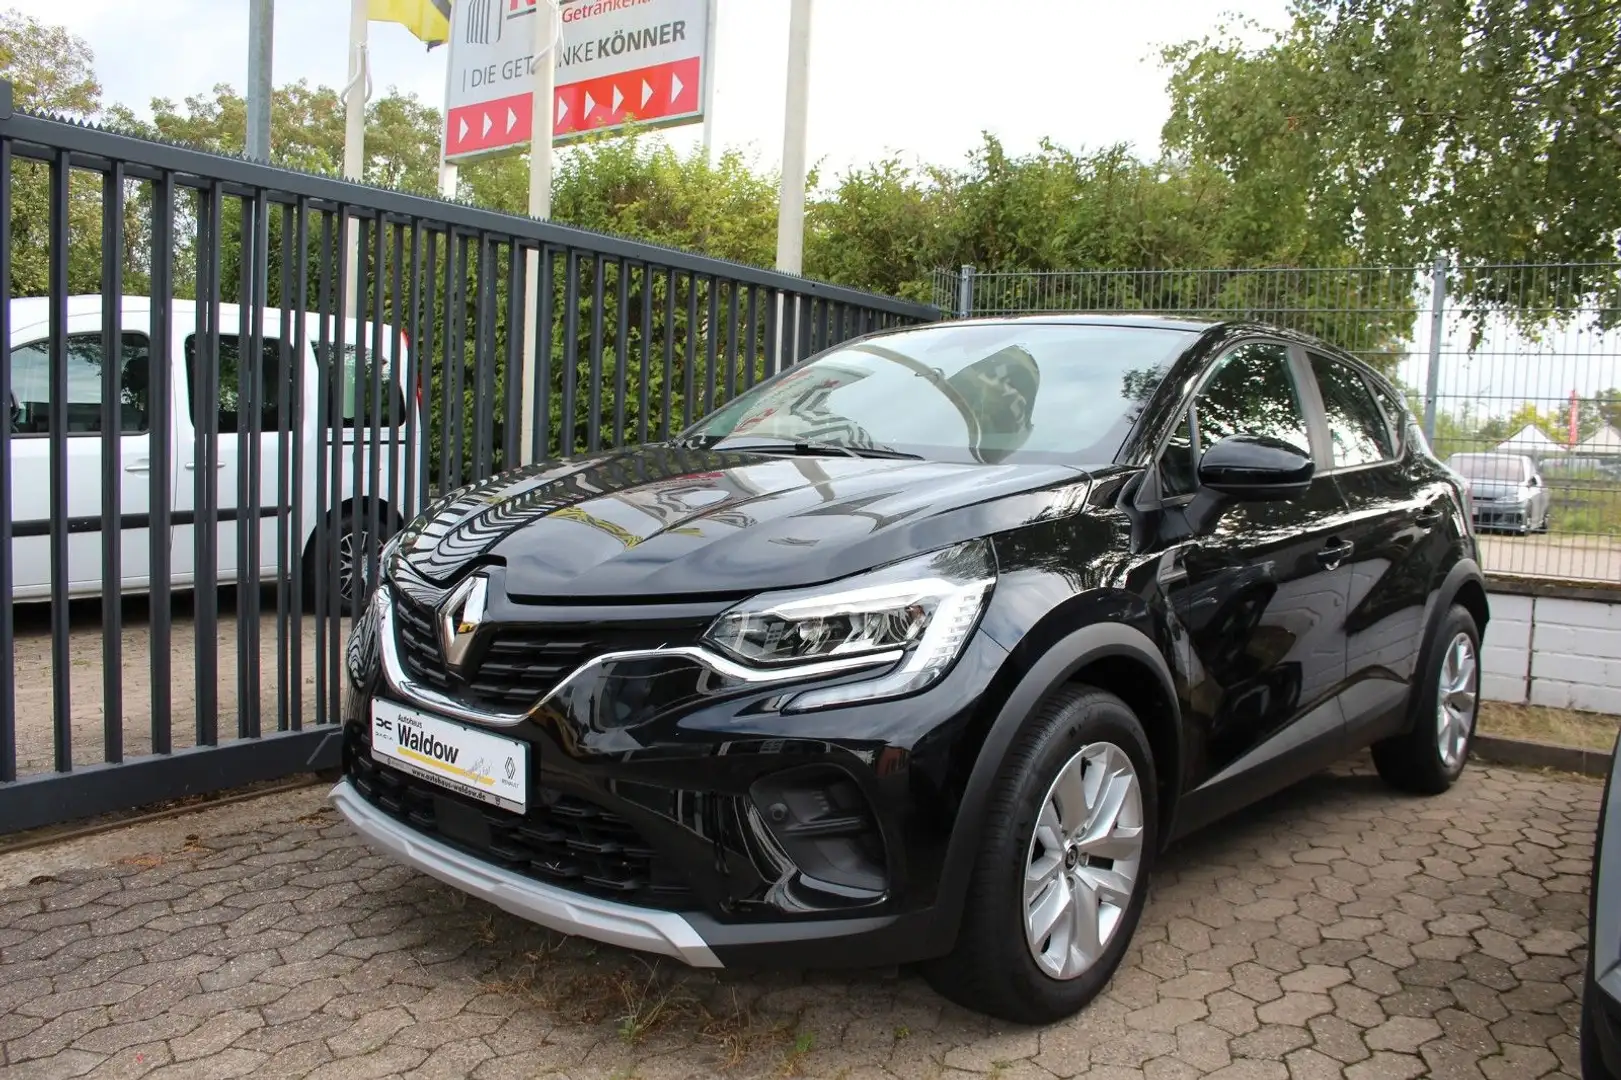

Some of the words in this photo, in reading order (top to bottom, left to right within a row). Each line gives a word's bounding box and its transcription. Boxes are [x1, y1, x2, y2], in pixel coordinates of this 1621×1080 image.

[471, 65, 496, 88] DIE
[502, 41, 594, 80] GETNKE
[598, 20, 686, 59] KÖNNER
[398, 722, 459, 764] Waldow
